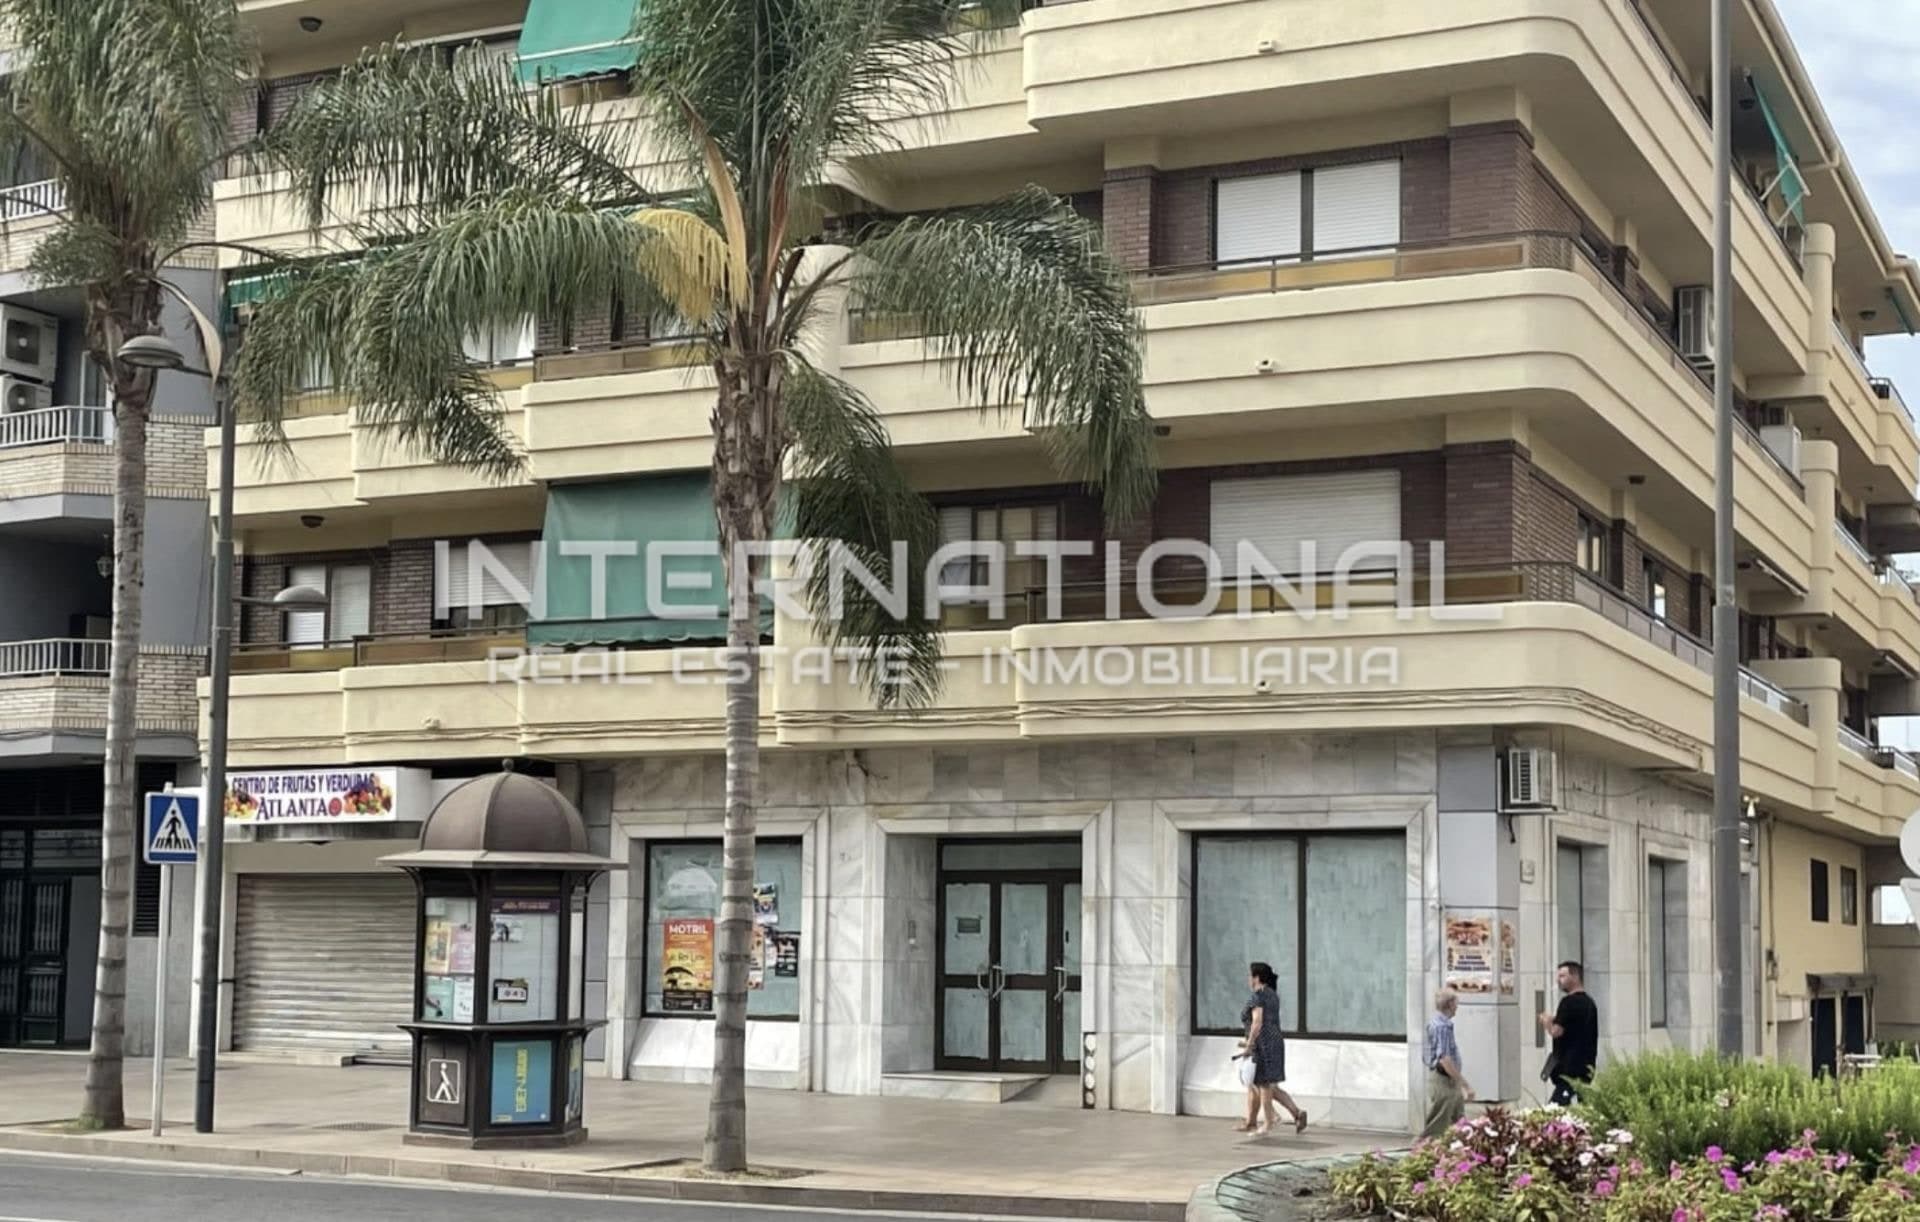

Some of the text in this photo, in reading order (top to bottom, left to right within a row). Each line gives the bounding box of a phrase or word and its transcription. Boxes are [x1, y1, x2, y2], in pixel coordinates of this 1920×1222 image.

[232, 775, 266, 794] CENTRO
[267, 775, 280, 793] DE
[282, 774, 316, 793] FRUTAS
[317, 775, 325, 792] Y
[256, 797, 329, 820] ATLANTA
[669, 924, 709, 935] MOTRIL
